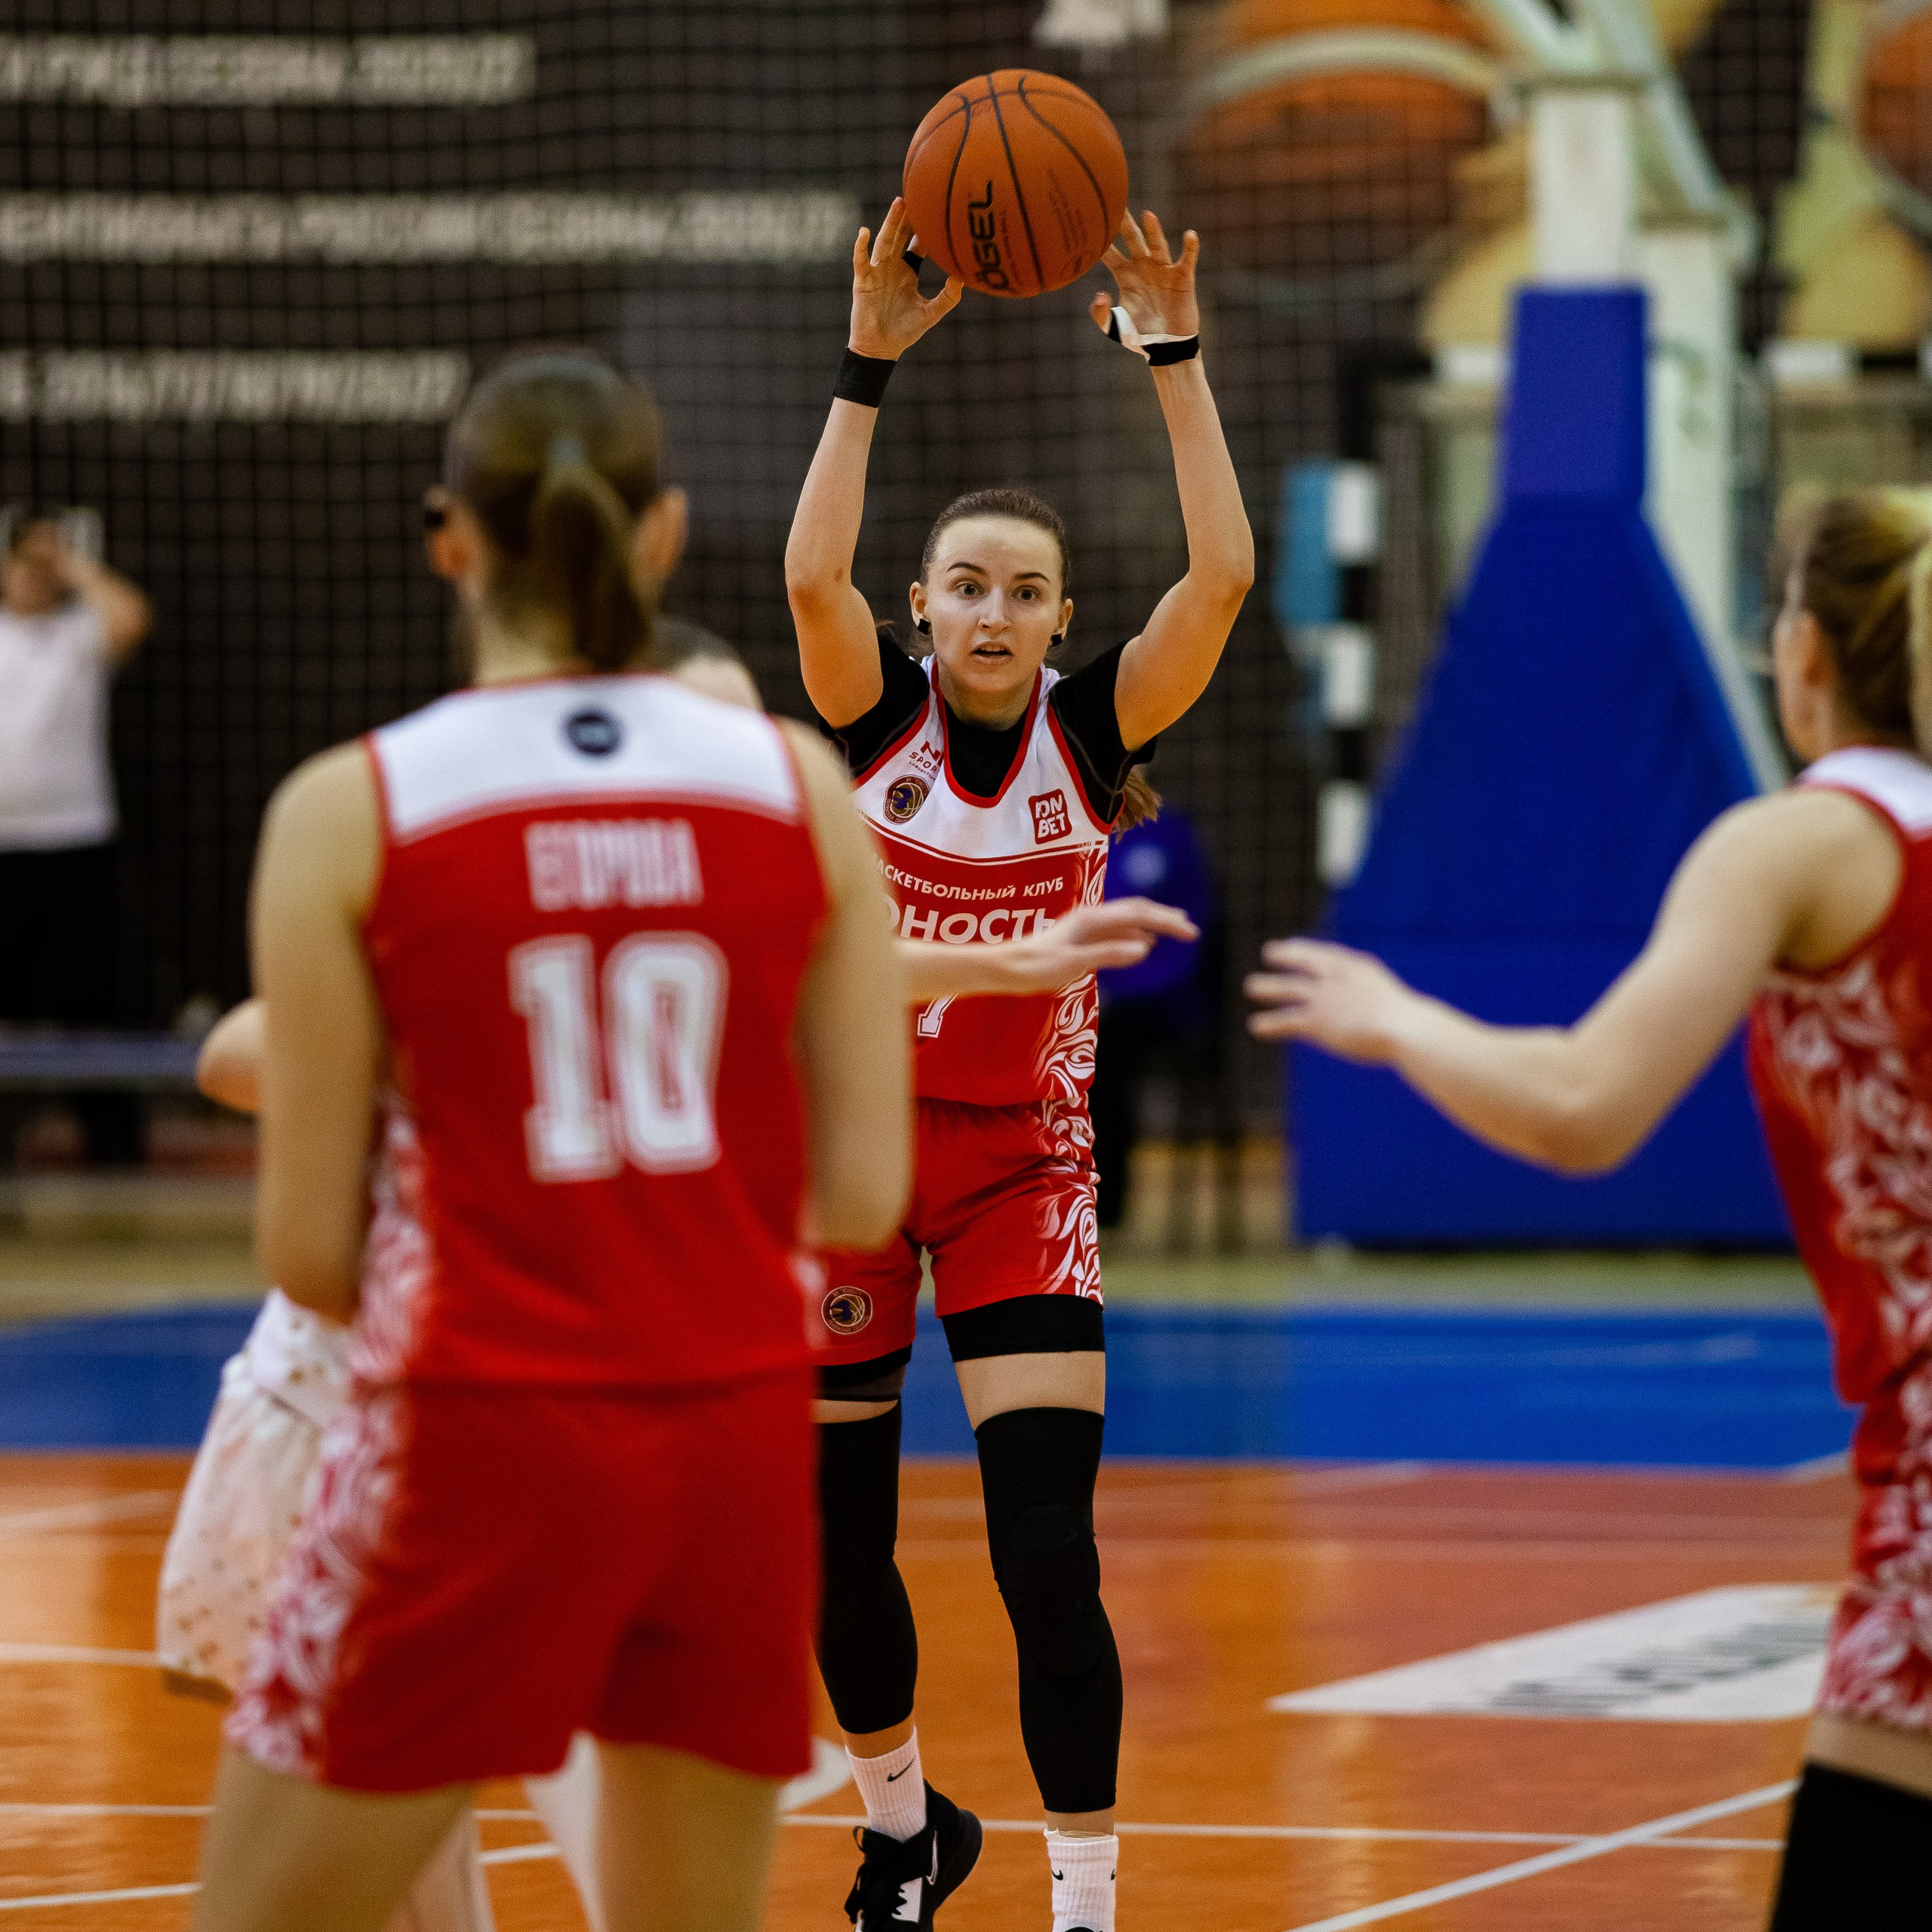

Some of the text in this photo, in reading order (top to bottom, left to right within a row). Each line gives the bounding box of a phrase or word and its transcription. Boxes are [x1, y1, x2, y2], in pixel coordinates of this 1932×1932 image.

[909, 752, 937, 774] SPOR
[1038, 812, 1066, 838] BET
[876, 859, 1064, 900] АСКЕТБОЛЬНЫЙ КЛУБ
[884, 894, 1057, 944] НОСТЬ
[507, 930, 730, 1183] 10
